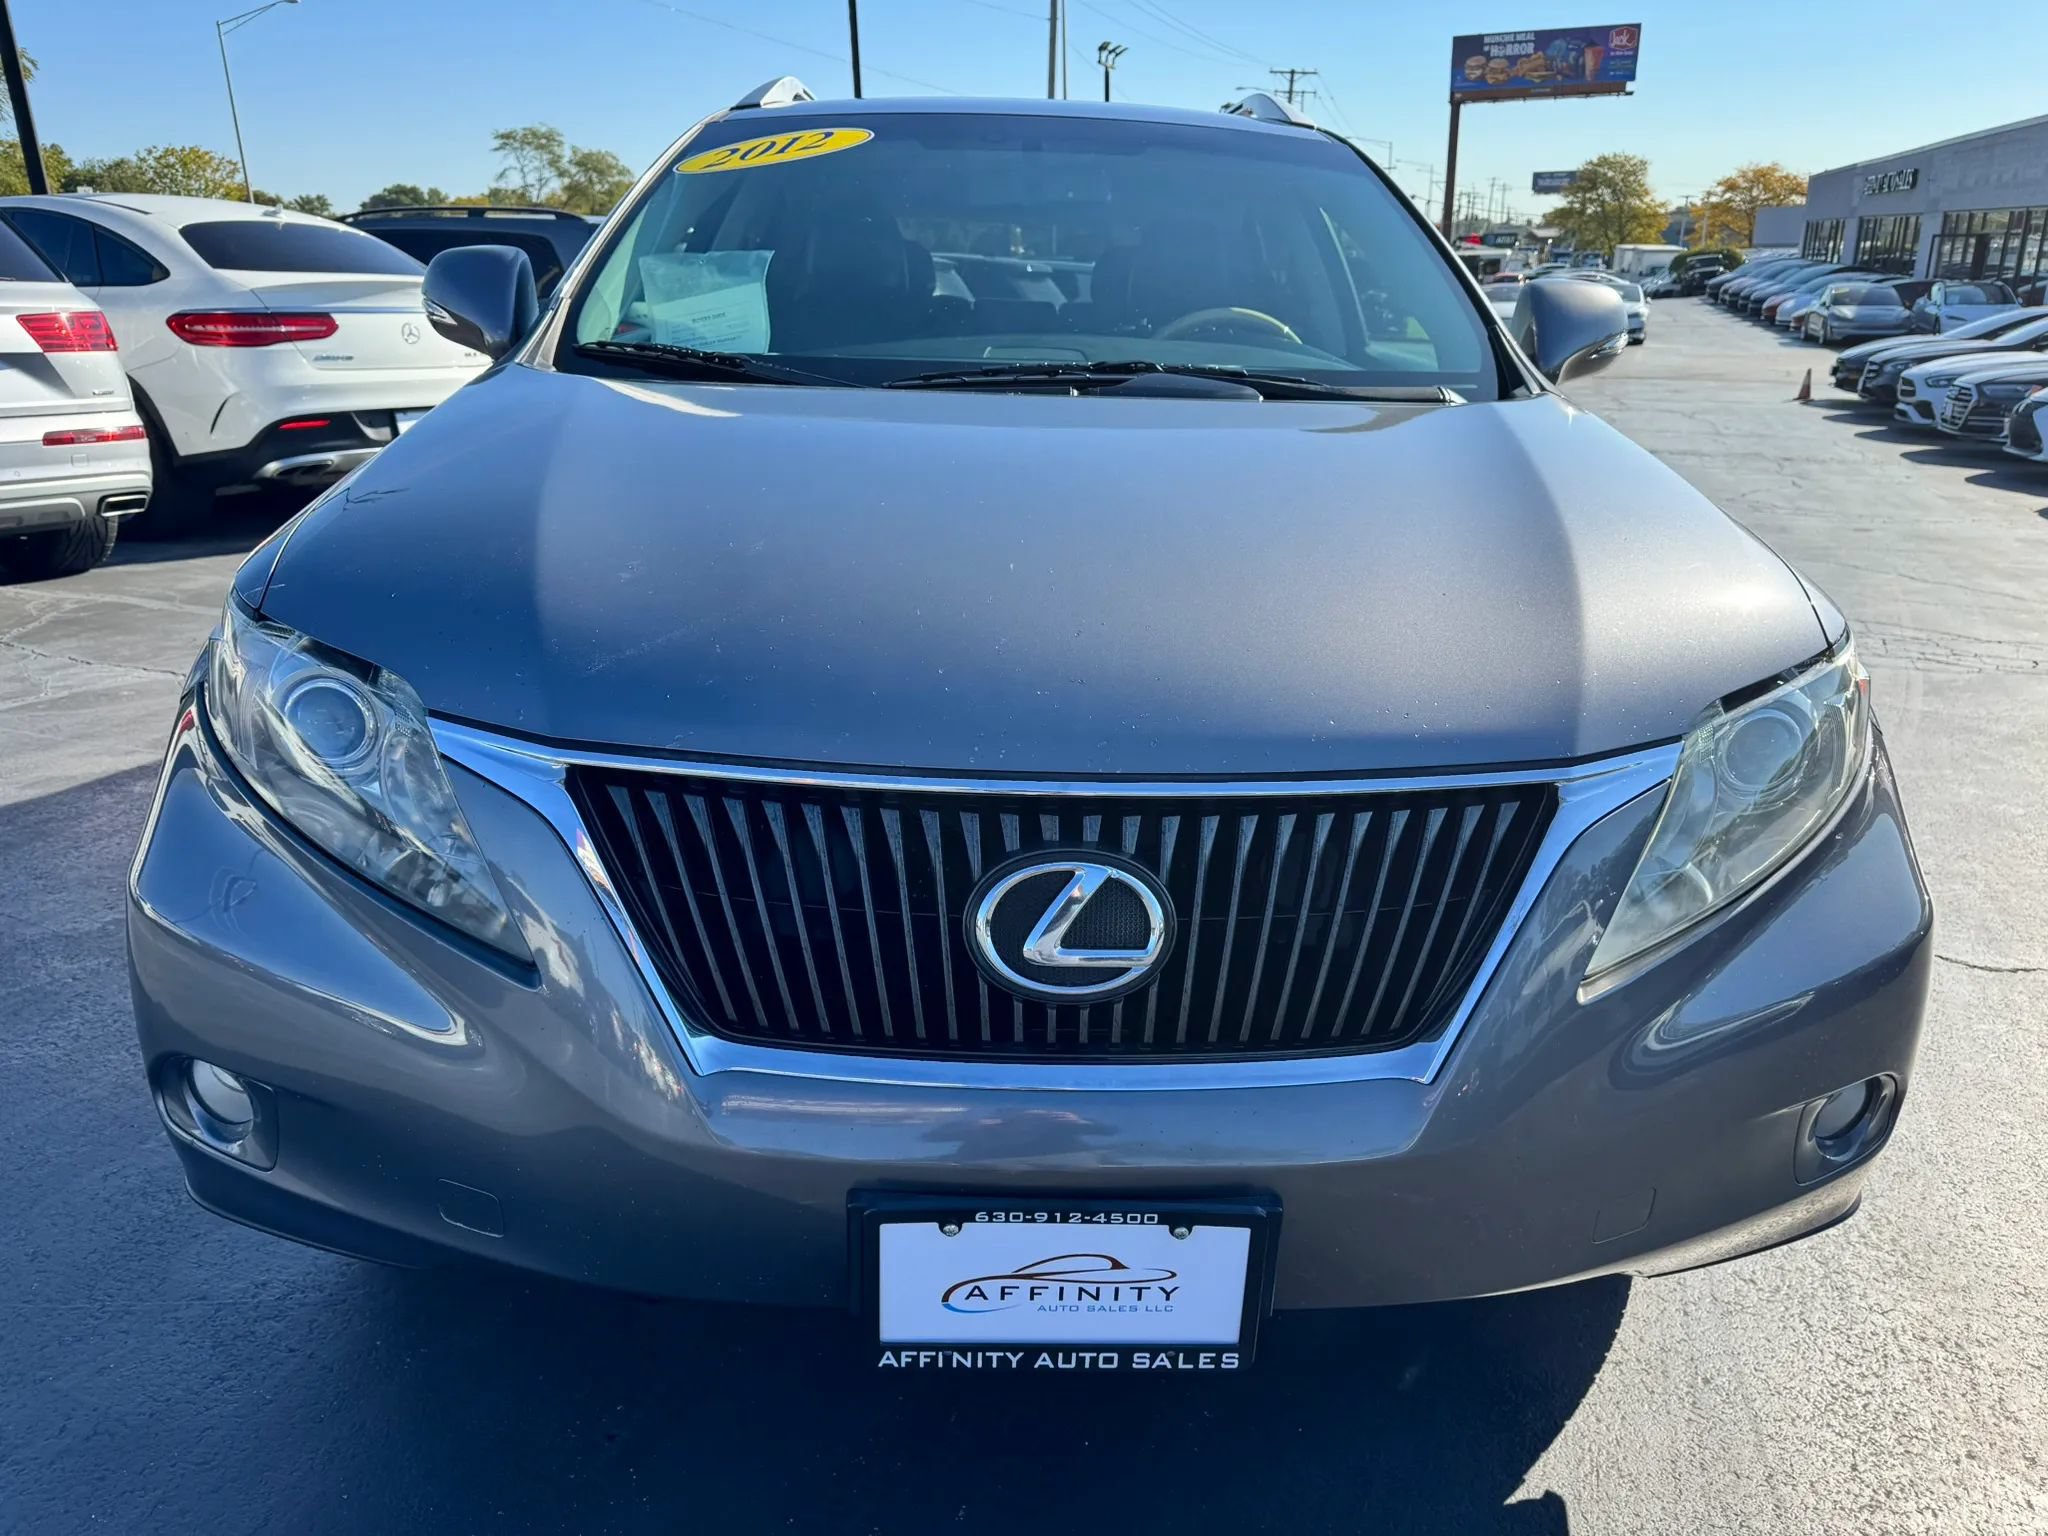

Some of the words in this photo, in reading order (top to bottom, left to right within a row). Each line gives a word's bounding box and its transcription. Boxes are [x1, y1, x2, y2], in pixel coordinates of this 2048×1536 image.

[1490, 42, 1535, 57] HORROR
[699, 131, 835, 170] 2012
[975, 1211, 1159, 1224] 630-912-4500
[964, 1285, 1181, 1301] AFFINITY
[1036, 1304, 1080, 1312] AUTO
[1086, 1304, 1138, 1312] SALES
[1144, 1304, 1174, 1312] LLC
[877, 1351, 1026, 1369] AFFINITY
[1033, 1351, 1119, 1369] AUTO
[1131, 1351, 1240, 1369] SALES
